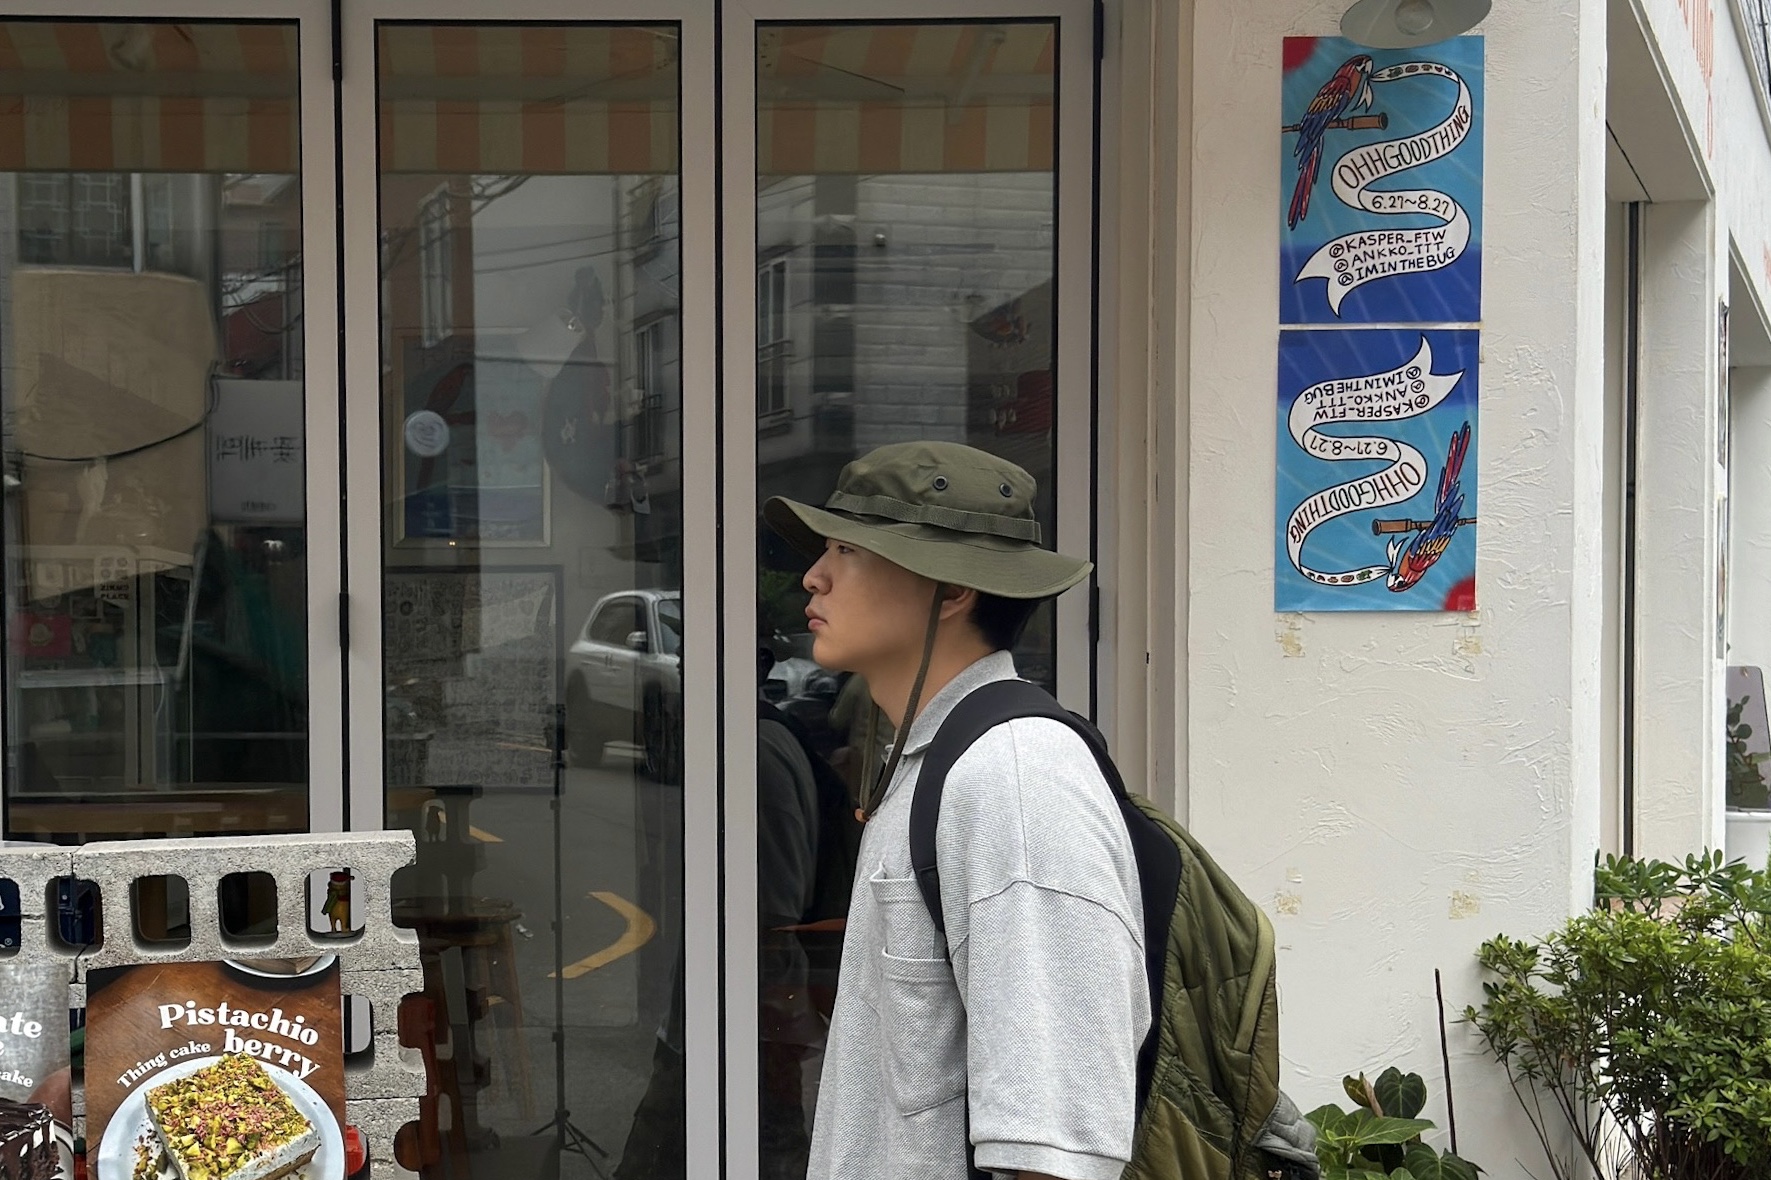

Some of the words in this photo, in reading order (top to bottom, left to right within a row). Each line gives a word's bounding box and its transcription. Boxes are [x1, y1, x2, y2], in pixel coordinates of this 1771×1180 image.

[1338, 105, 1470, 189] OHHGOODTHING
[1371, 194, 1450, 216] 6.27~8.27
[1329, 229, 1446, 258] @KASPER_FTW
[1333, 241, 1444, 272] @ANKKO_TTT
[1313, 394, 1430, 421] @KASPER_FTW
[1316, 379, 1425, 410] @ANKKO_TTT
[1309, 435, 1388, 456] 6.27~8.27
[157, 1000, 319, 1046] Pistachio
[116, 1052, 168, 1088] Thing
[169, 1040, 211, 1059] cake
[222, 1028, 321, 1080] berry
